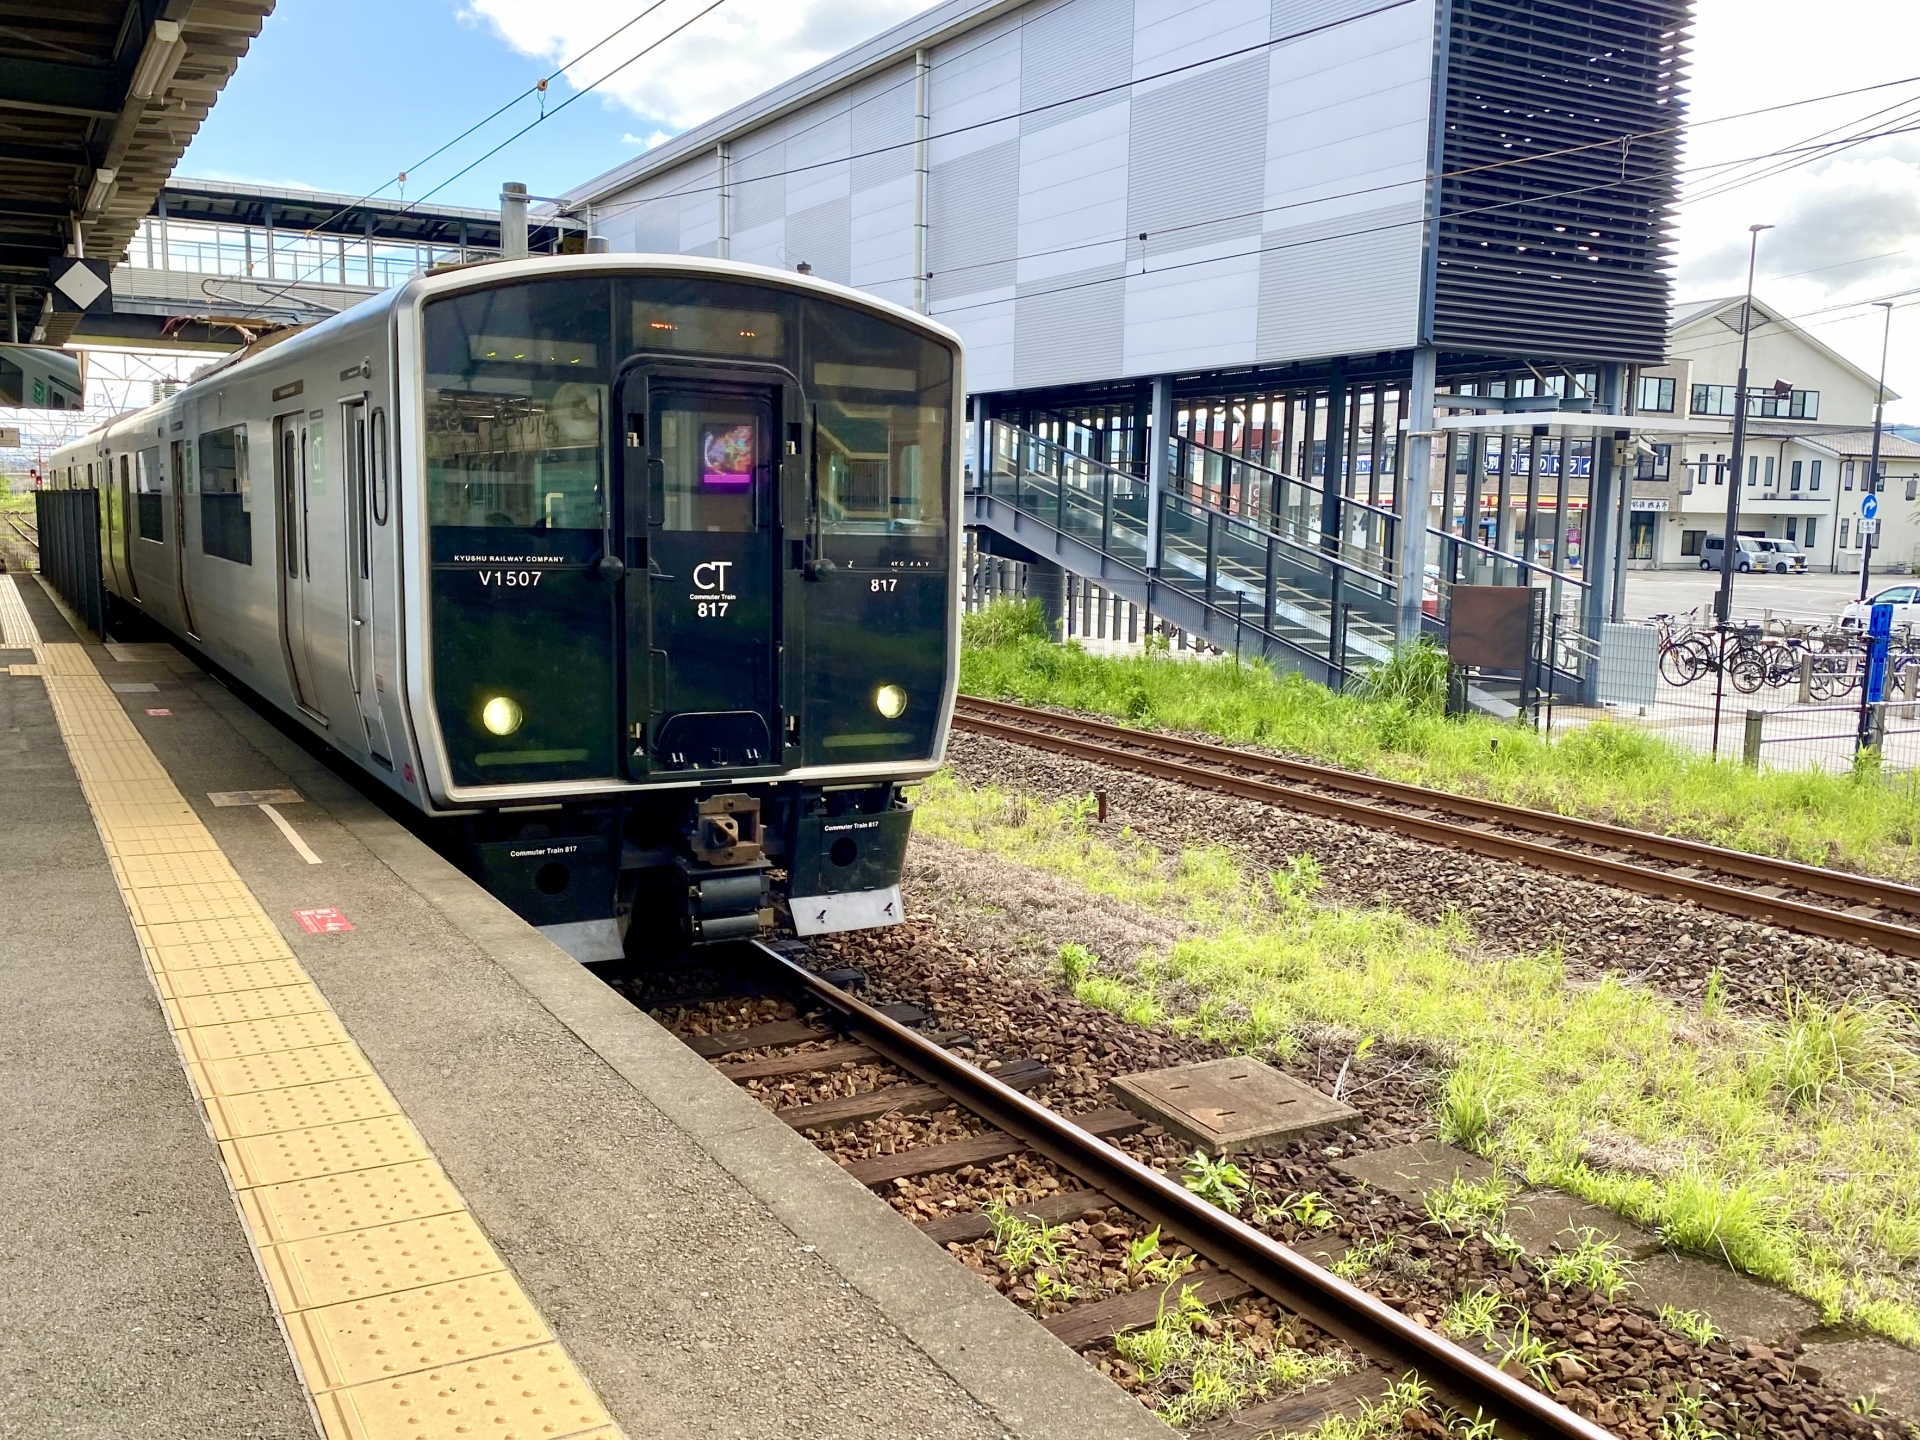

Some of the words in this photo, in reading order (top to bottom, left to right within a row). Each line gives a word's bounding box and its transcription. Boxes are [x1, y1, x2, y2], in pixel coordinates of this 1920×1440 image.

[479, 571, 542, 586] V1507
[693, 561, 732, 591] CT
[870, 579, 898, 592] 817
[697, 602, 728, 617] 817
[510, 849, 546, 857] Commuter
[547, 846, 564, 854] Train
